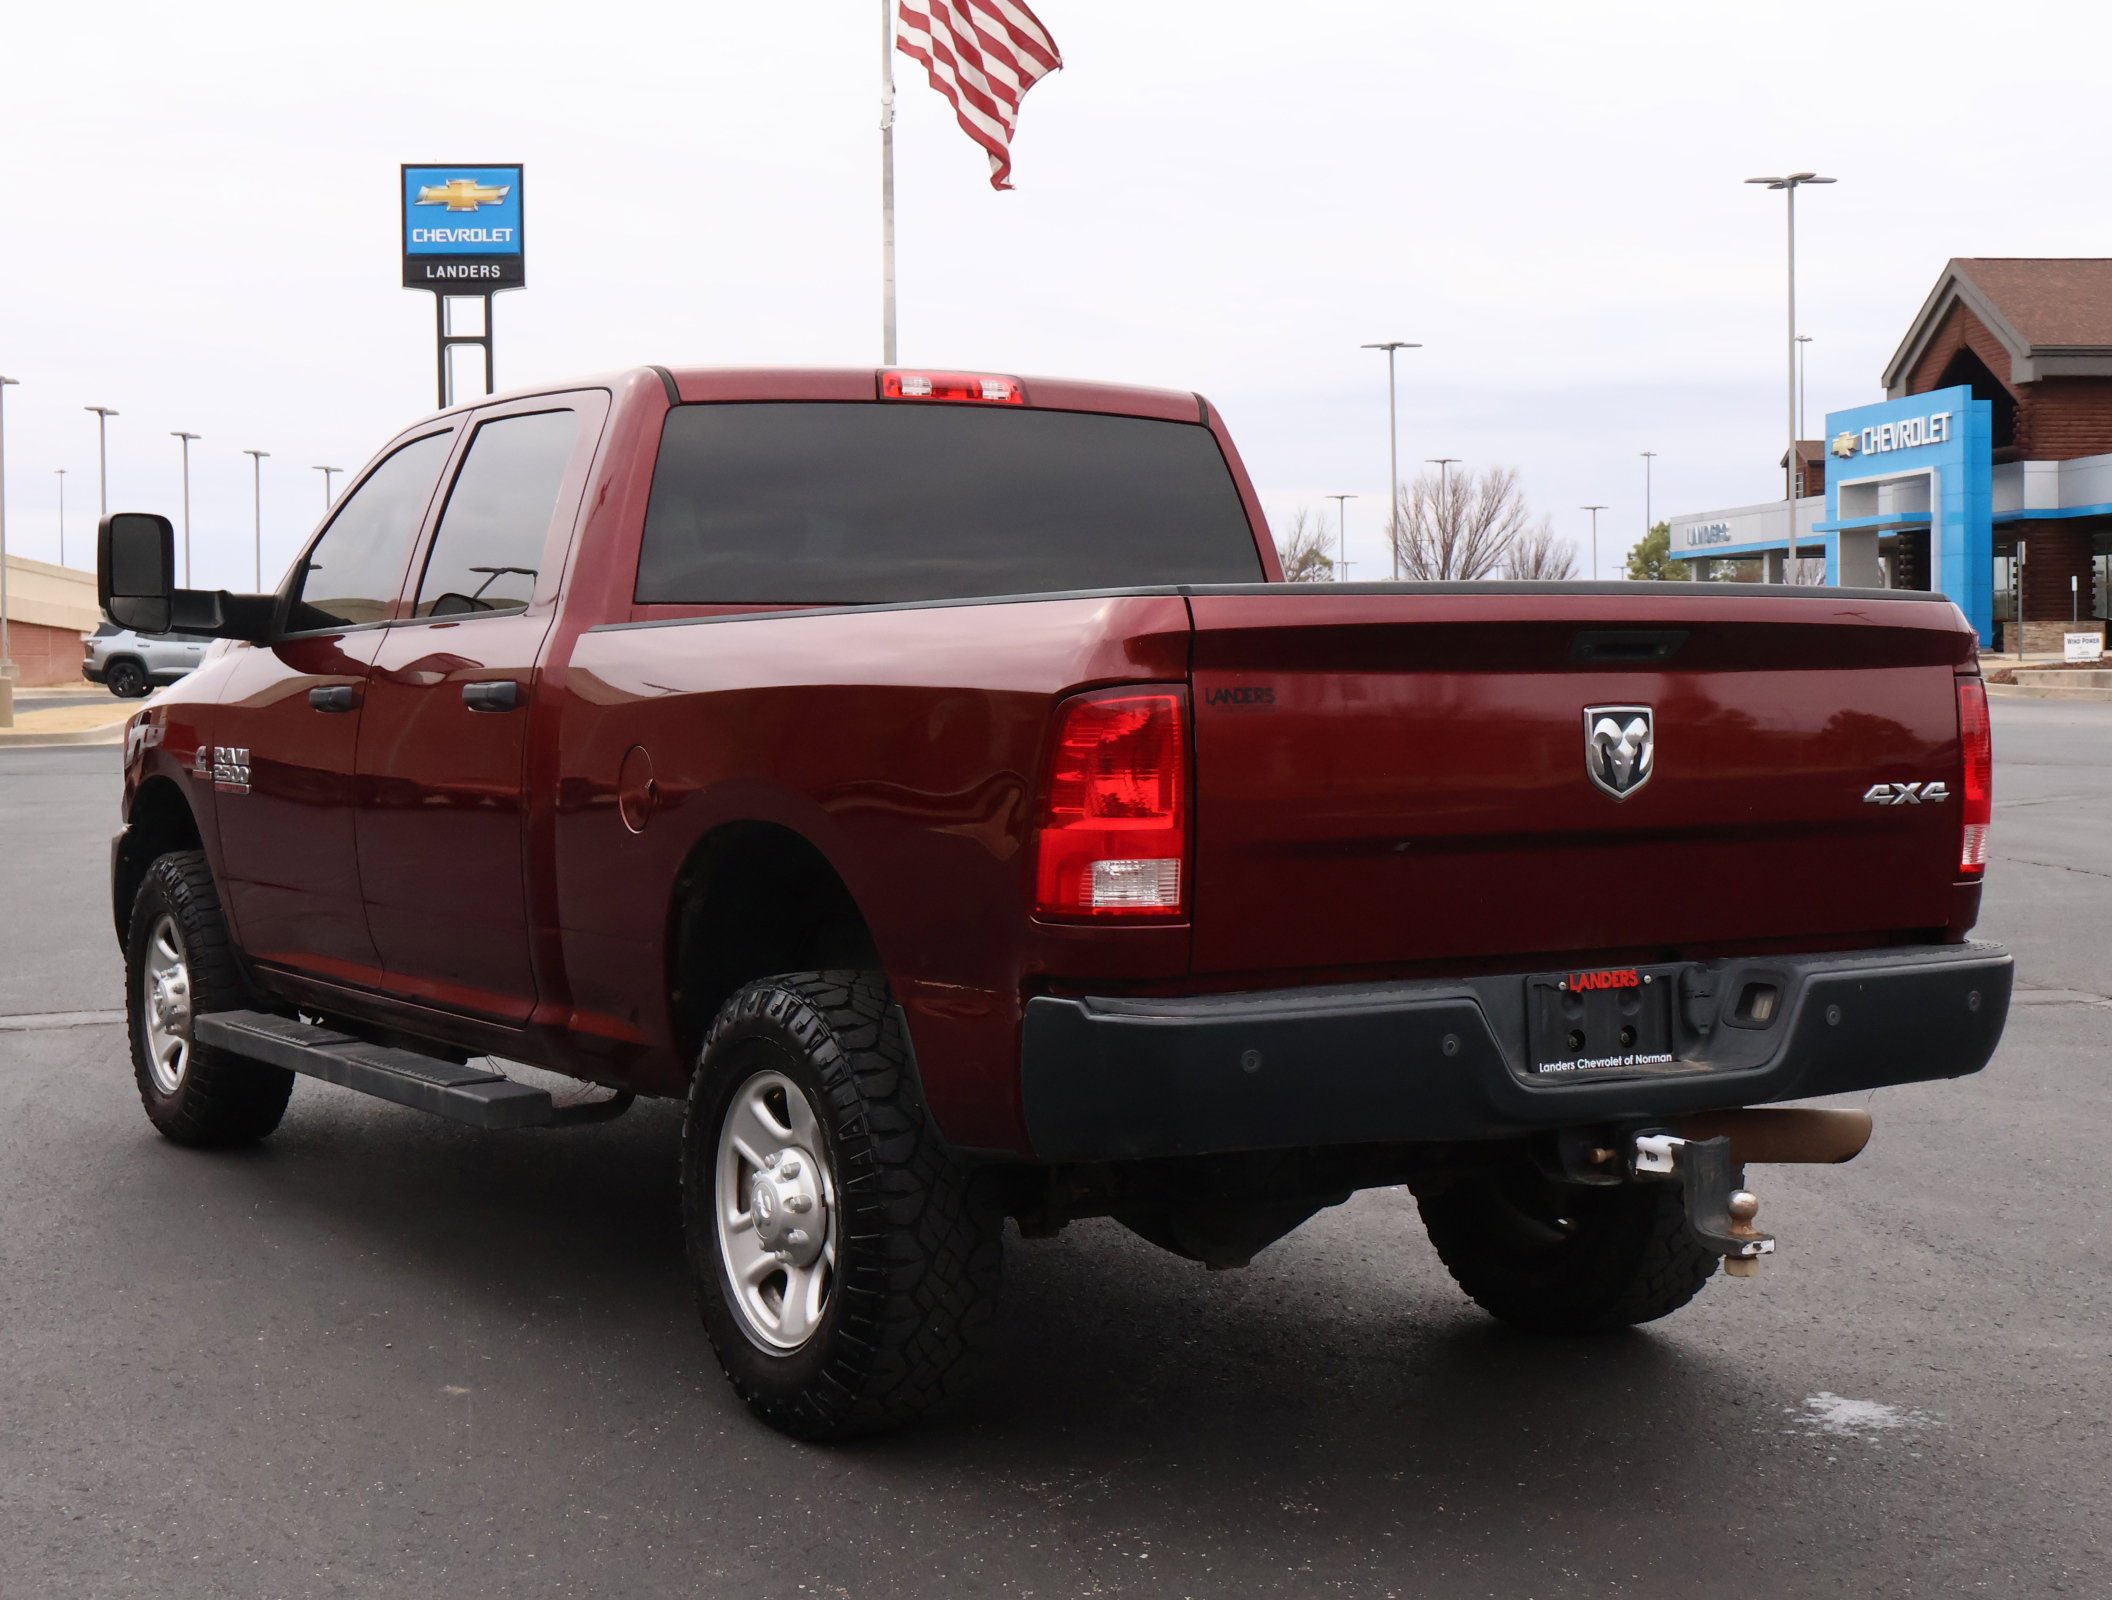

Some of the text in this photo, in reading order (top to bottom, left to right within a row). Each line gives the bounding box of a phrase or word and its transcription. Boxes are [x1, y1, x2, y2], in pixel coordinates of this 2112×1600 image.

[412, 228, 513, 242] CHEVROLET
[426, 265, 501, 278] LANDERS
[1861, 411, 1952, 456] CHEVROLET
[1204, 687, 1276, 706] LANDERS
[213, 764, 250, 783] 2500
[1568, 970, 1639, 993] LANDERS
[1539, 1053, 1672, 1073] Landers Chevrolet of Norman
